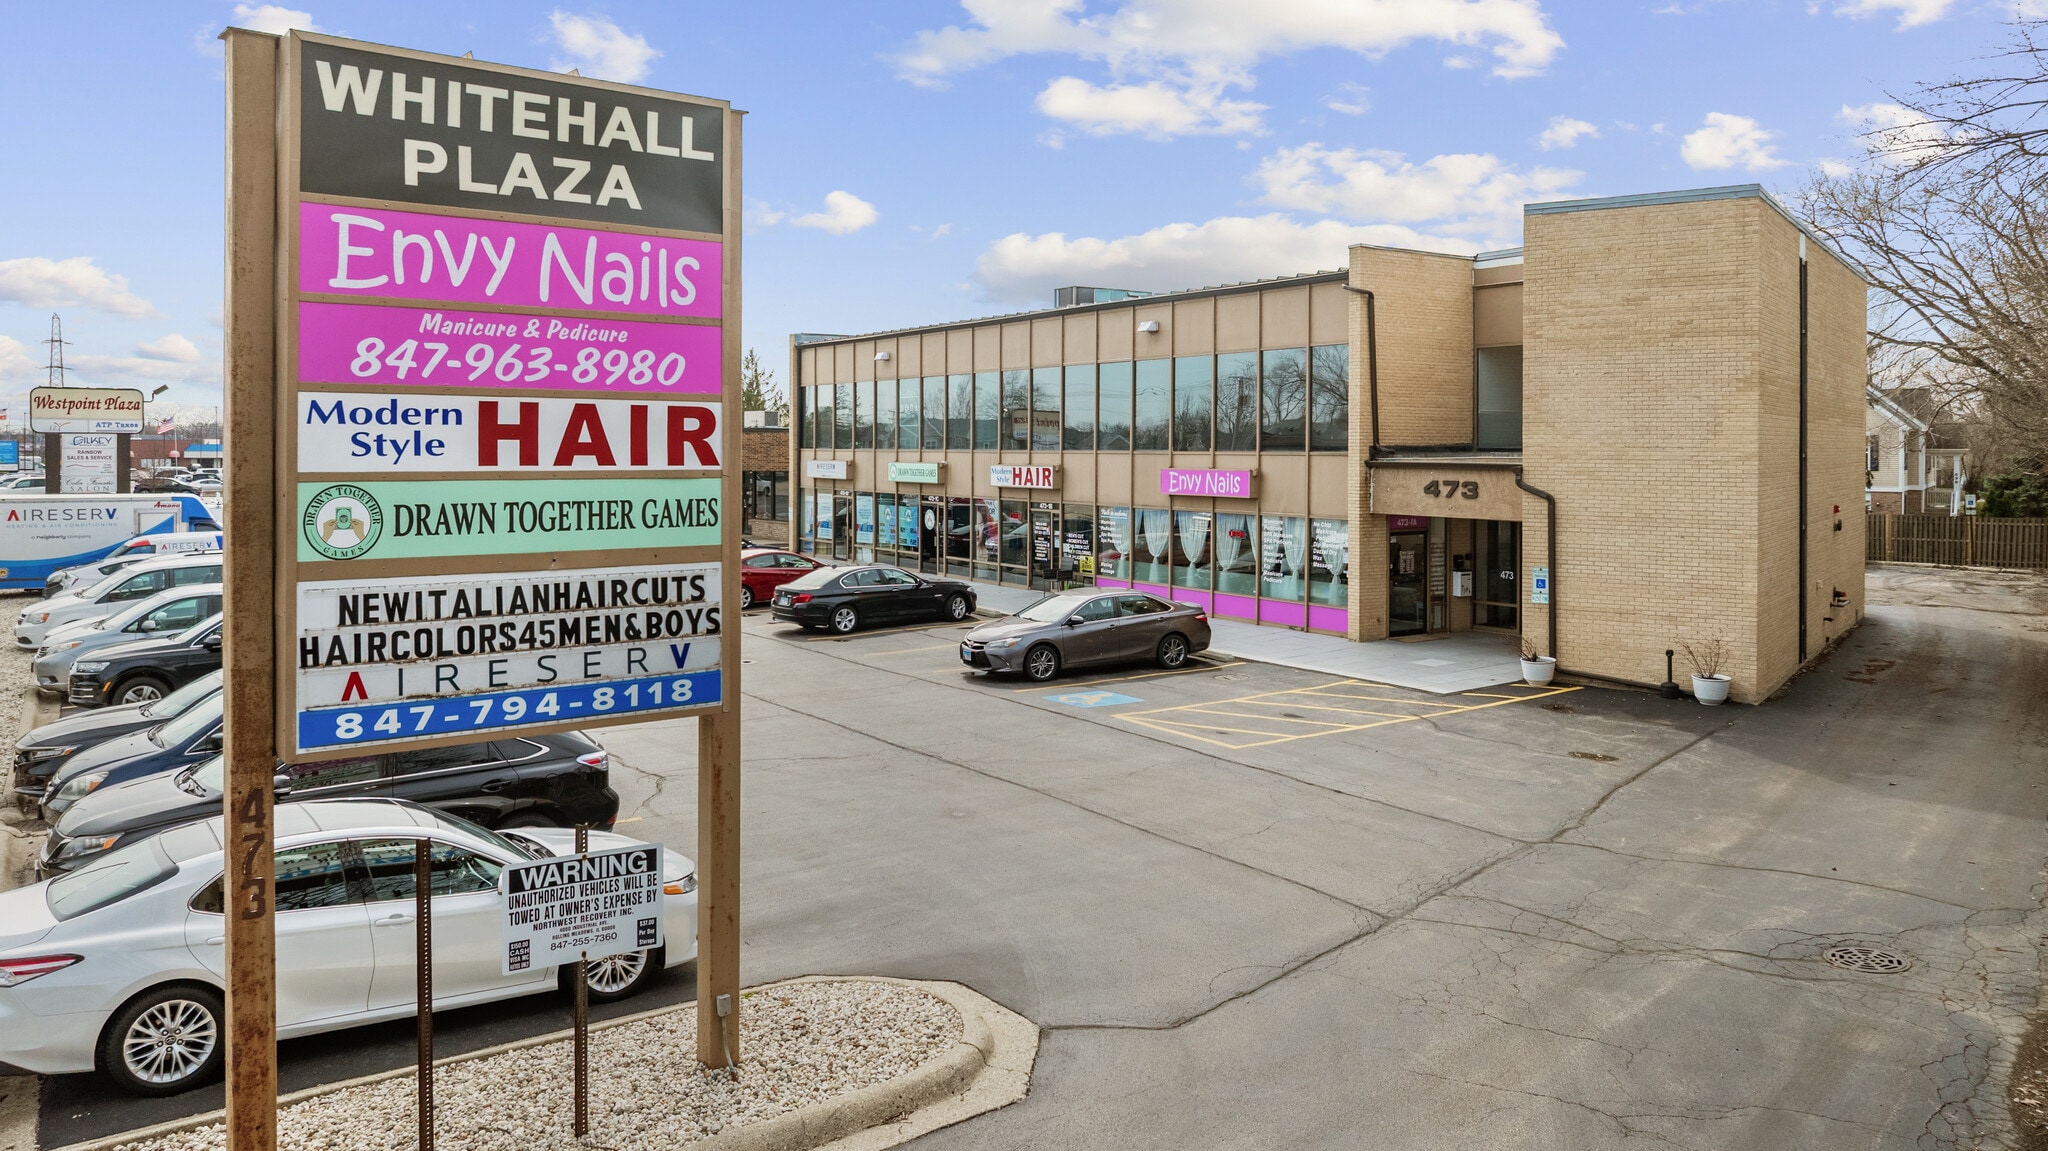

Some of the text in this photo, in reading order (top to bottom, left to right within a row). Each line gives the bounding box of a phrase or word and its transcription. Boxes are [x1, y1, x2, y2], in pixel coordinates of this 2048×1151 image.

[315, 60, 715, 162] WHITEHALL
[404, 138, 642, 210] PLAZA
[328, 213, 701, 308] Envy Nails
[419, 313, 629, 343] Manicure & Pedicure
[350, 337, 686, 387] 847-963-8980
[33, 395, 142, 415] Westpoint Plaza
[306, 399, 463, 427] Modern
[72, 436, 112, 445] GILKEY
[350, 430, 446, 465] Style
[477, 400, 721, 467] HAIR
[991, 467, 1012, 475] Modern
[1012, 467, 1052, 487] HAIR
[1168, 471, 1241, 495] Envy Nails
[1423, 480, 1479, 500] 473
[7, 508, 118, 521] AIRESERV
[305, 487, 381, 526] DRAWN TOGETHER
[393, 498, 719, 537] DRAWN TOGETHER GAMES
[323, 545, 364, 557] GAMES
[1500, 570, 1514, 580] 473
[335, 679, 694, 740] 847-794-8118
[240, 786, 267, 921] 473
[519, 851, 648, 891] WARNING
[508, 873, 658, 910] UNAUTHORIZED VEHICLES WILL BE
[508, 889, 658, 926] TOWED AT OWNER'S EXPENSE BY
[532, 907, 635, 932] NORTHWEST RECOVERY INC.
[572, 921, 598, 931] INDUSTRIAL
[509, 947, 530, 957] CASH
[550, 931, 618, 951] 847-255-7360
[509, 955, 521, 963] VISA
